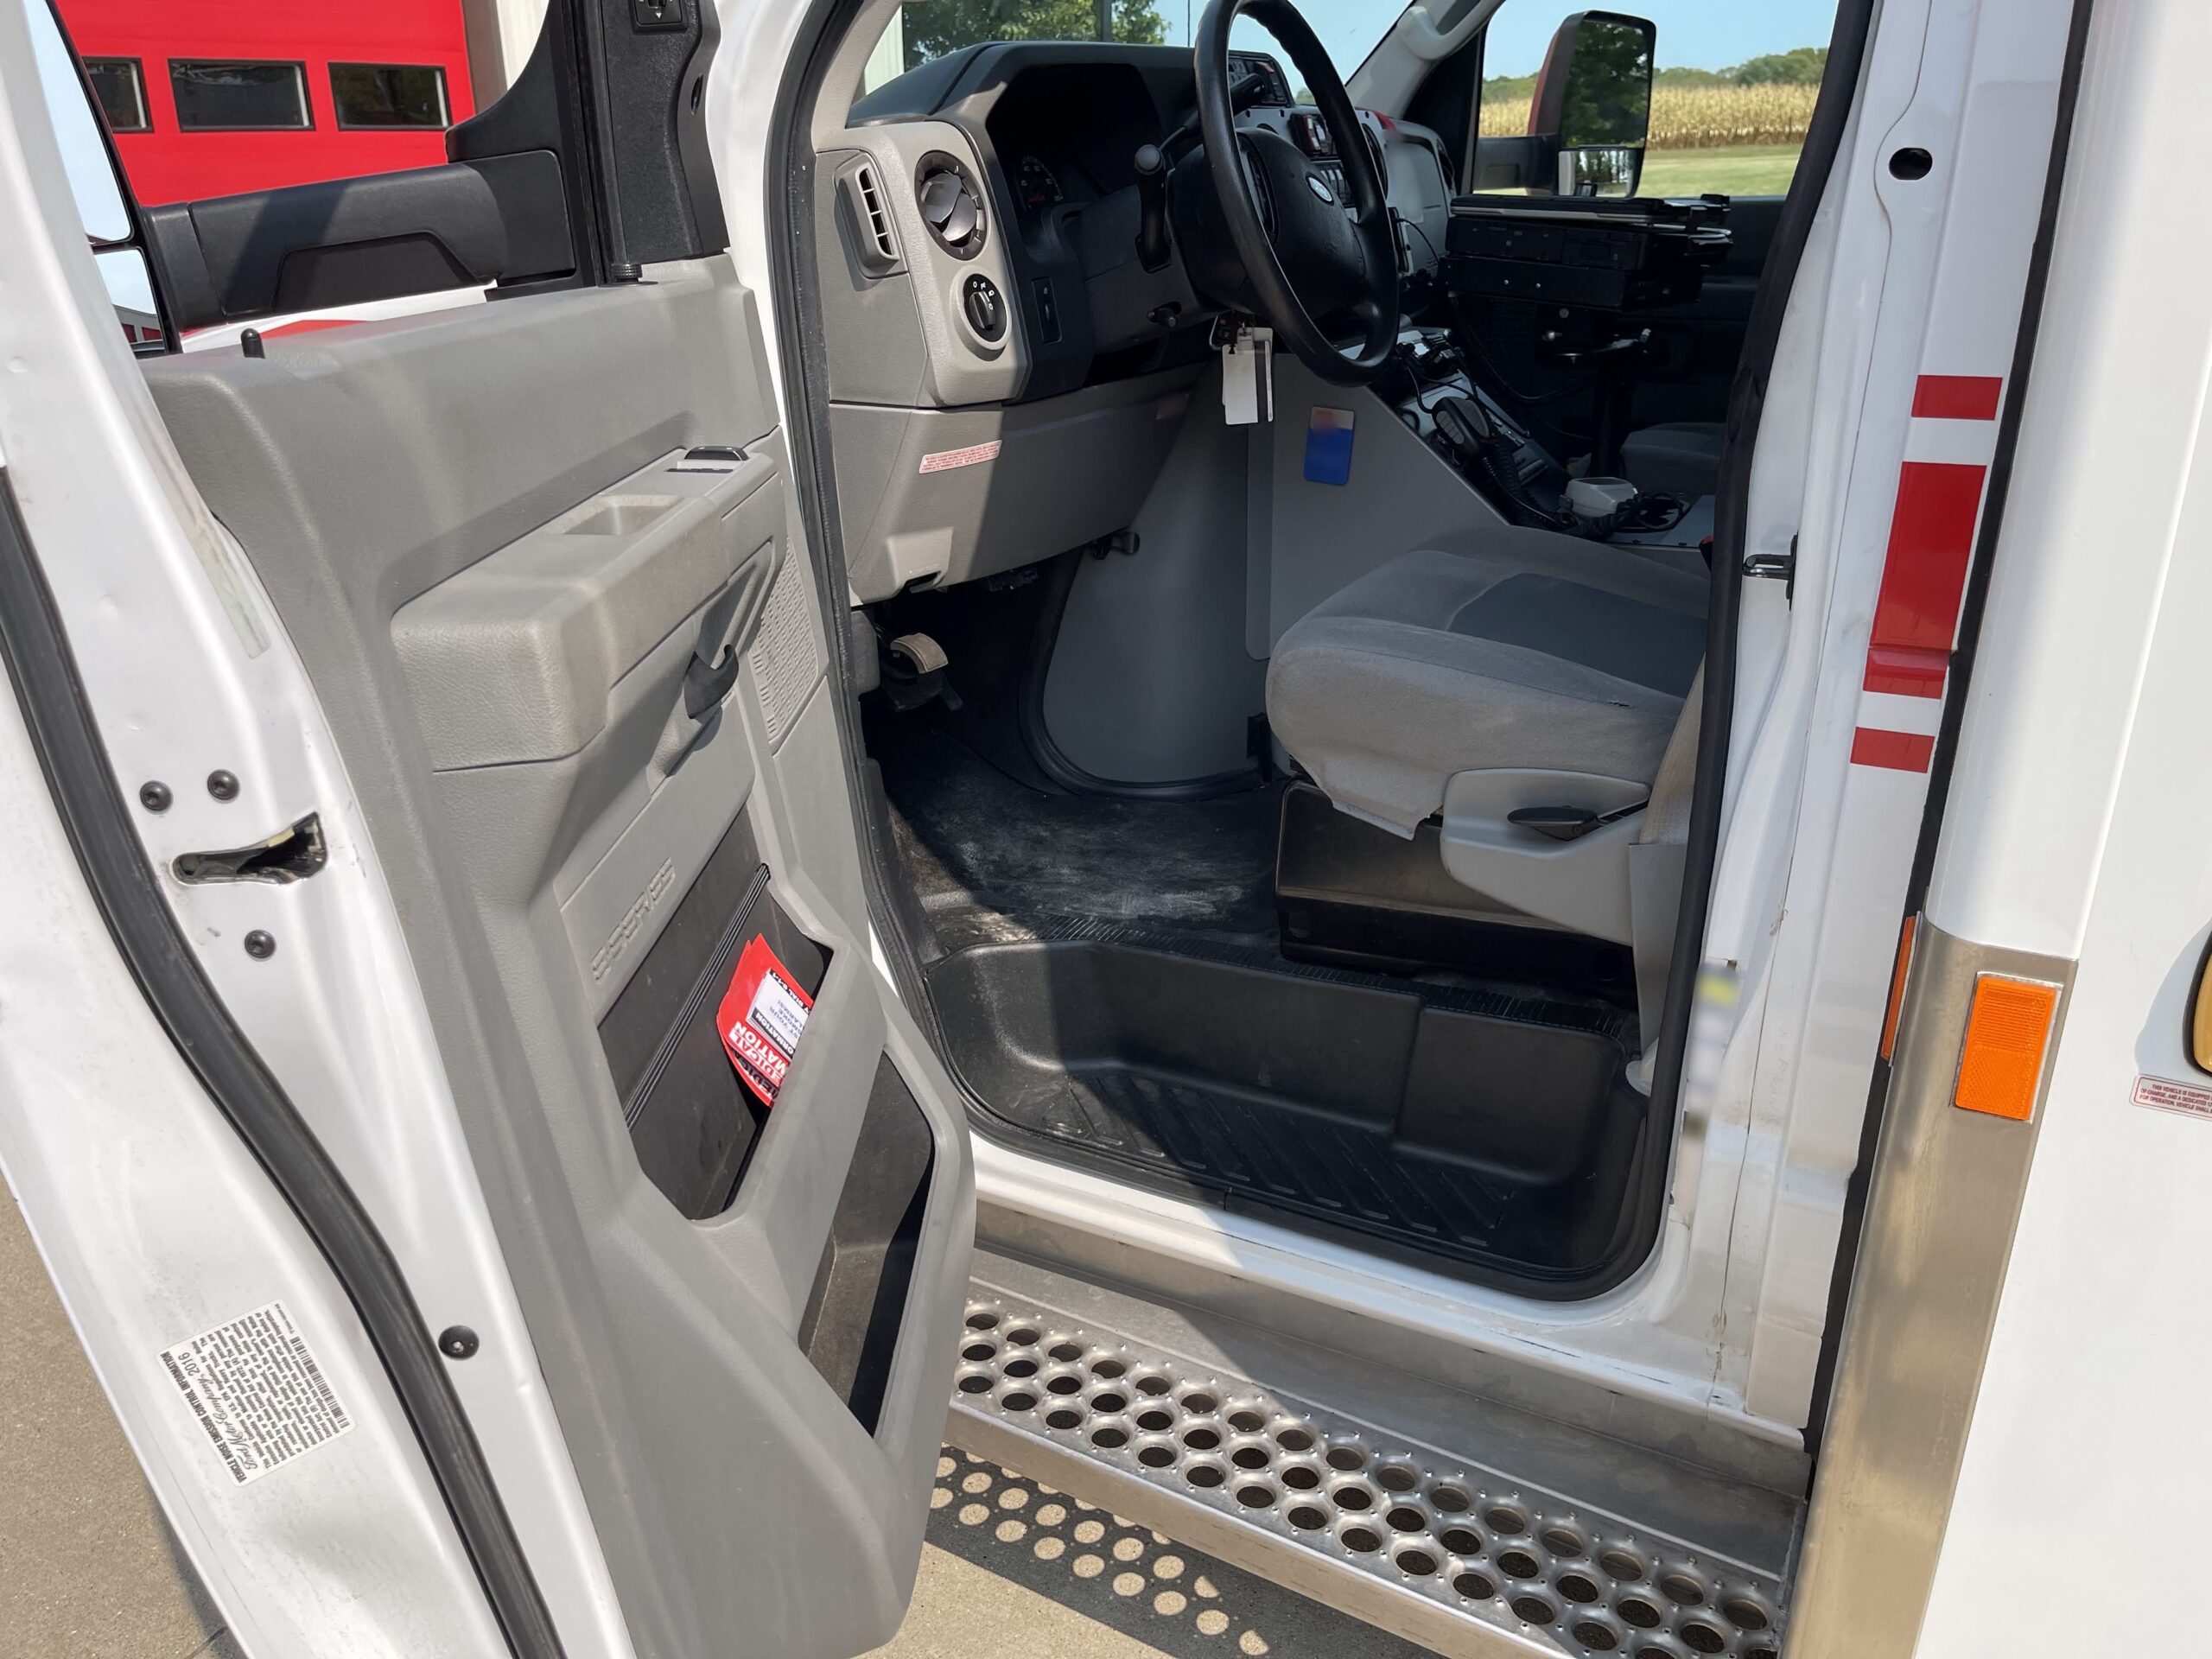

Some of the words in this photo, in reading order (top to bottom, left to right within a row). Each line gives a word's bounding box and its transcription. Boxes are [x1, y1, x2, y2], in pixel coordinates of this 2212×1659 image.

[778, 1000, 803, 1028] LARMS!
[755, 1012, 794, 1055] ORMATION
[734, 1020, 787, 1075] MATION
[734, 1031, 782, 1082] EDICAL
[2163, 1085, 2182, 1095] VEHICLE
[2176, 1102, 2196, 1110] VEHICLE
[161, 1351, 191, 1391] INFORMATION
[178, 1352, 200, 1376] 2016
[185, 1389, 207, 1416] CONTROL
[200, 1415, 223, 1444] EMISSION
[224, 1421, 249, 1452] Motor
[217, 1441, 233, 1460] NOISE
[237, 1444, 257, 1470] Ford
[226, 1459, 247, 1483] VEHICLE
